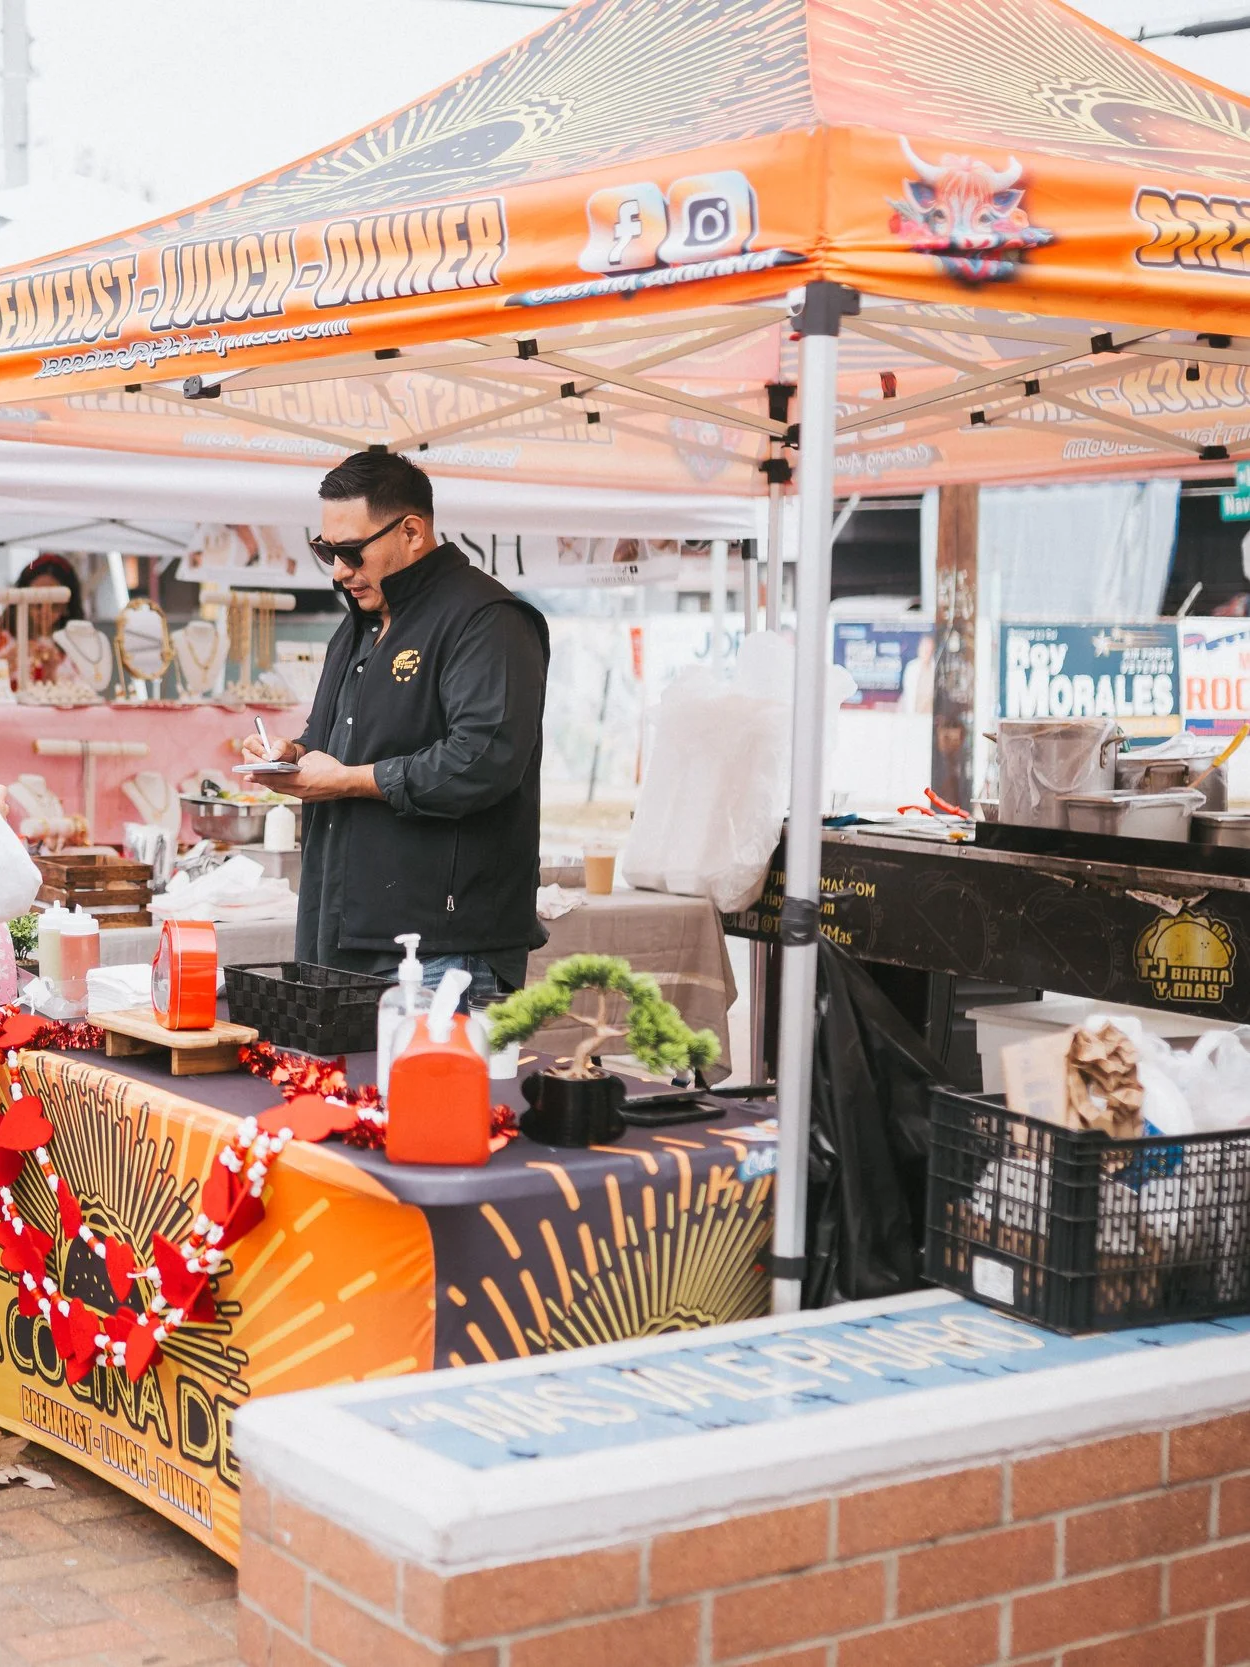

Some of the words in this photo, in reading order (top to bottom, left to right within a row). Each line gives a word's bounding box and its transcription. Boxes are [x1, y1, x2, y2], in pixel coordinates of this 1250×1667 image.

[149, 228, 298, 332] LUNCH
[313, 196, 508, 309] DINNER
[1007, 636, 1068, 676] Roy
[1007, 672, 1174, 717] MORALES
[1138, 958, 1168, 979] TJ
[1171, 967, 1230, 983] BIRRIA
[1156, 981, 1168, 996] Y
[1173, 983, 1220, 999] MAS
[587, 1350, 822, 1412] VALE
[21, 1384, 92, 1455] BREAKFAST
[100, 1424, 149, 1489] LUNCH
[156, 1456, 214, 1530] DINNER
